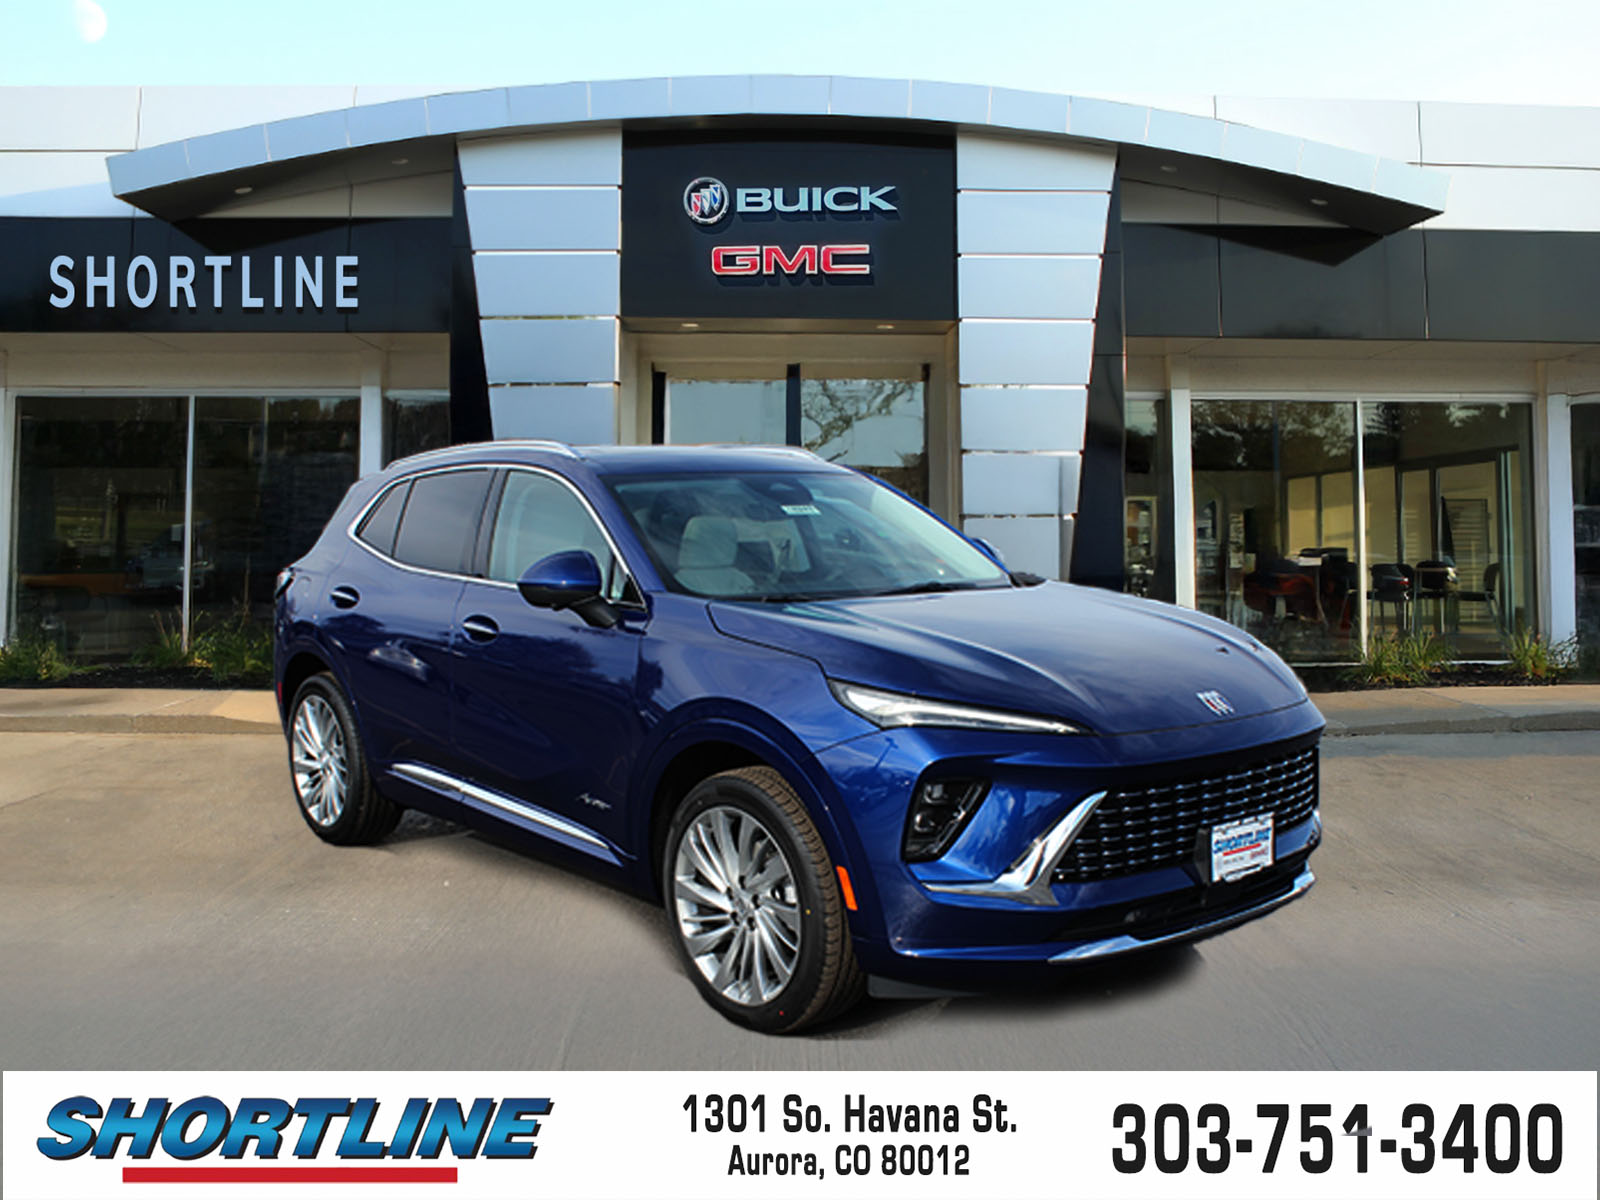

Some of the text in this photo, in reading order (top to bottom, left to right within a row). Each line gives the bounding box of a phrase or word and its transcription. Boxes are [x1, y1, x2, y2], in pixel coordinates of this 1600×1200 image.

[736, 186, 898, 212] BUICK
[711, 244, 870, 275] GMC
[49, 255, 359, 309] SHORTLINE
